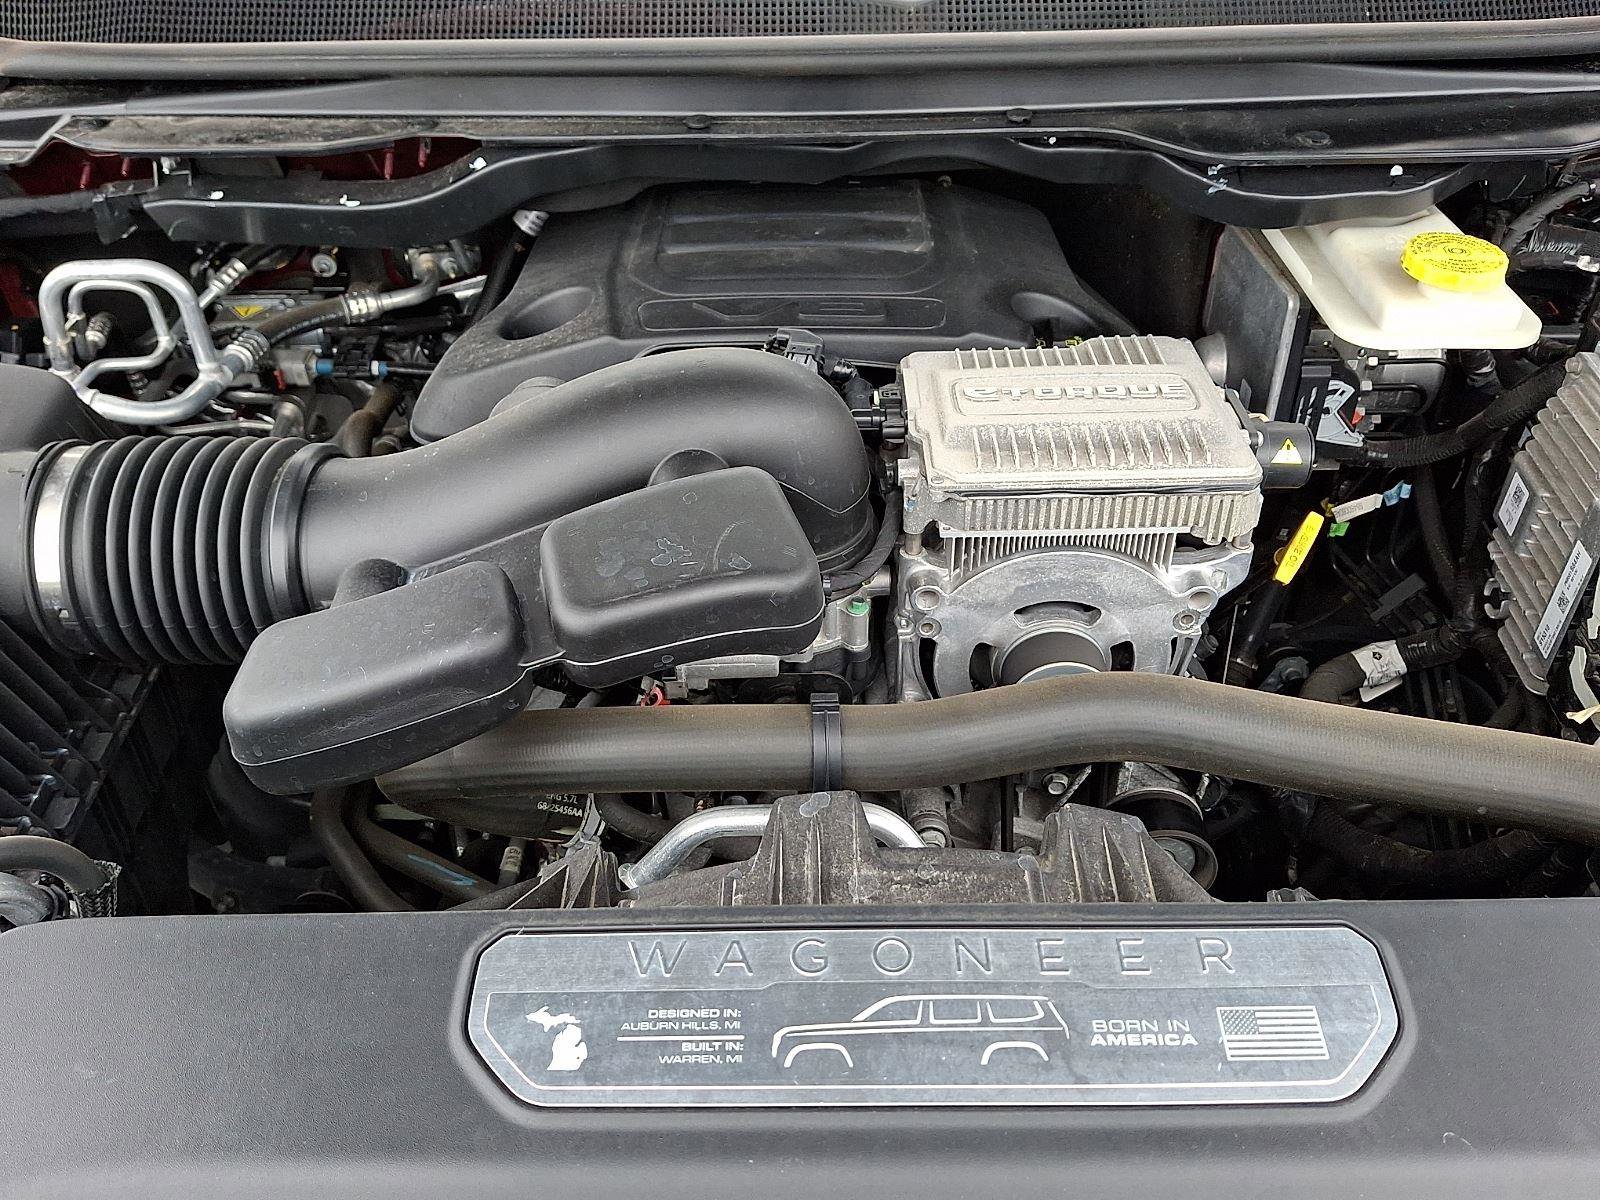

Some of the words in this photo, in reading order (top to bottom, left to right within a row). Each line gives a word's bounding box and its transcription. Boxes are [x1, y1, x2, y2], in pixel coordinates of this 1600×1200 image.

[563, 794, 578, 804] 5.7L
[537, 801, 582, 817] 6825456AA
[628, 937, 1235, 977] WAGONEER
[648, 1009, 720, 1019] DESIGNED
[723, 1008, 742, 1018] IN:
[620, 1021, 679, 1030] AUBURN
[724, 1021, 741, 1029] MI
[1092, 1019, 1159, 1032] BORN
[1167, 1019, 1191, 1032] IN
[1090, 1033, 1199, 1046] AMERICA
[681, 1042, 722, 1051] BUILT
[725, 1042, 744, 1050] IN:
[725, 1055, 743, 1063] MI
